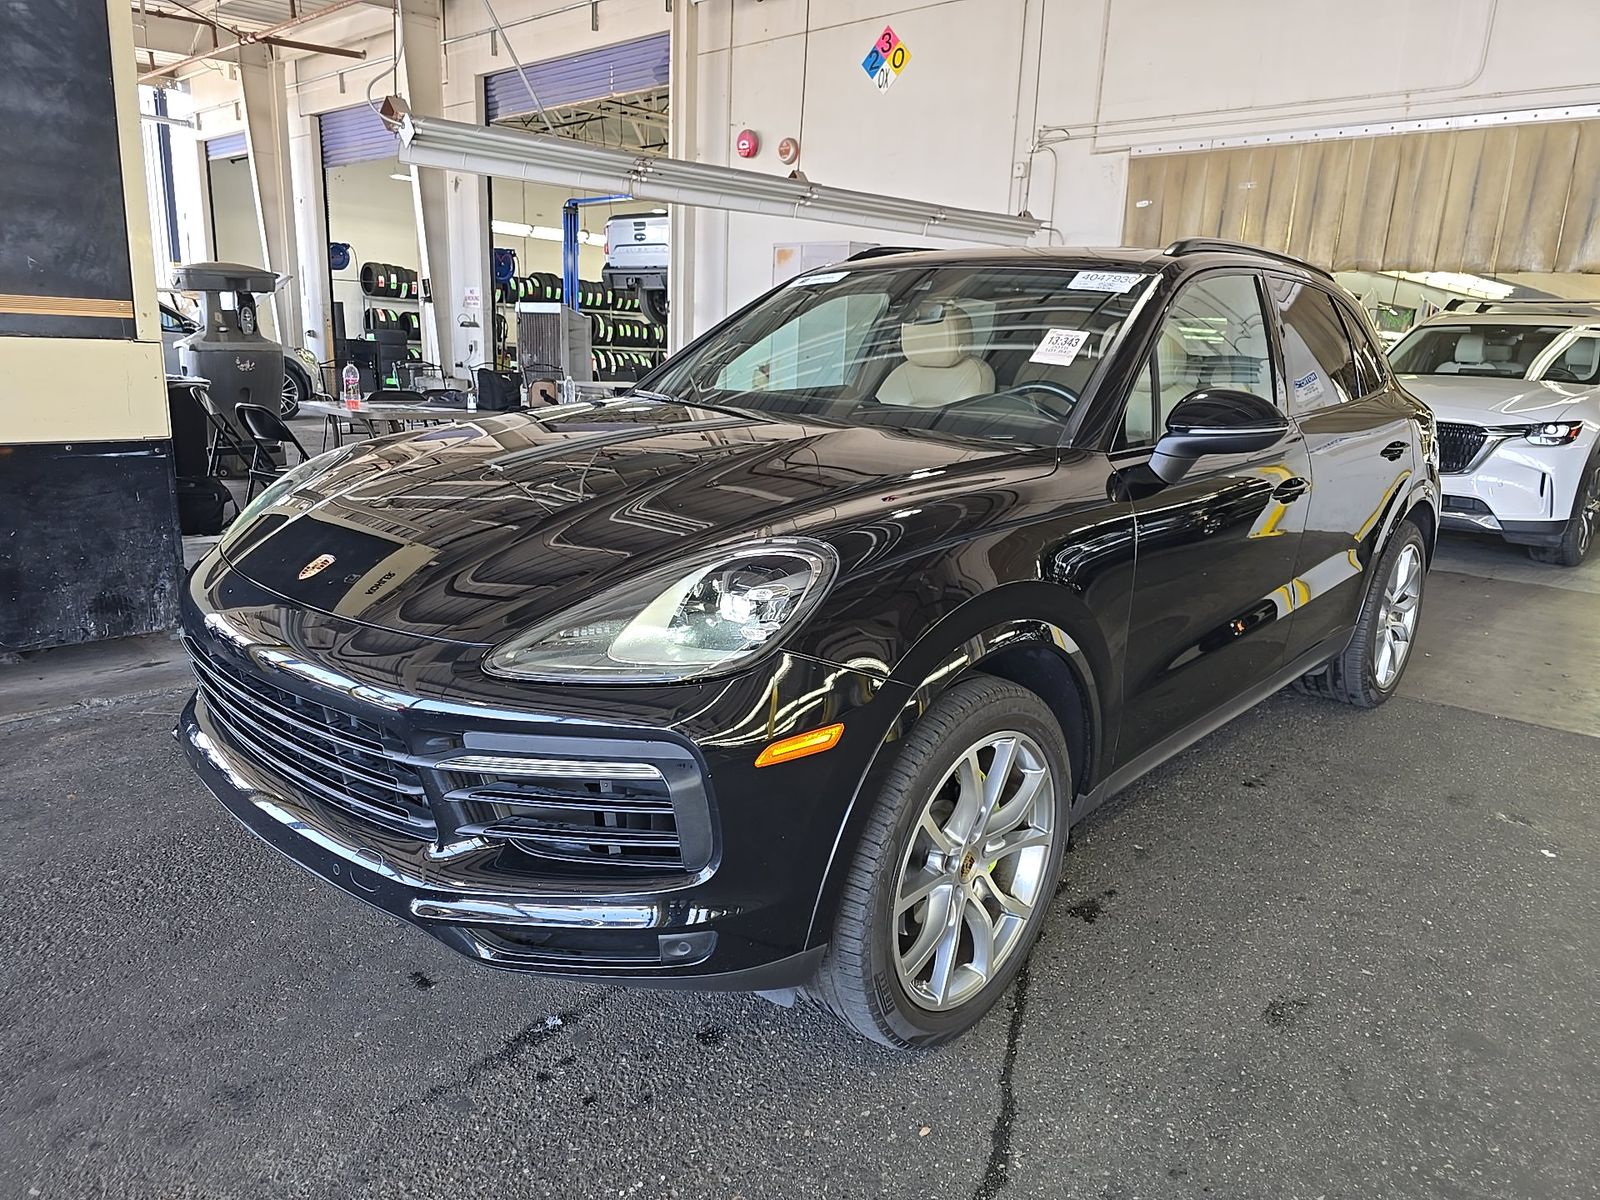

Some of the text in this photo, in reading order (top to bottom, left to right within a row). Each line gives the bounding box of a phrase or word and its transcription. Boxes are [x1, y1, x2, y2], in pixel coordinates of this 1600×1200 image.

[881, 32, 892, 53] 3
[869, 49, 880, 71] 2
[892, 47, 905, 69] 0
[878, 68, 890, 89] OX
[1048, 335, 1080, 347] 13:343
